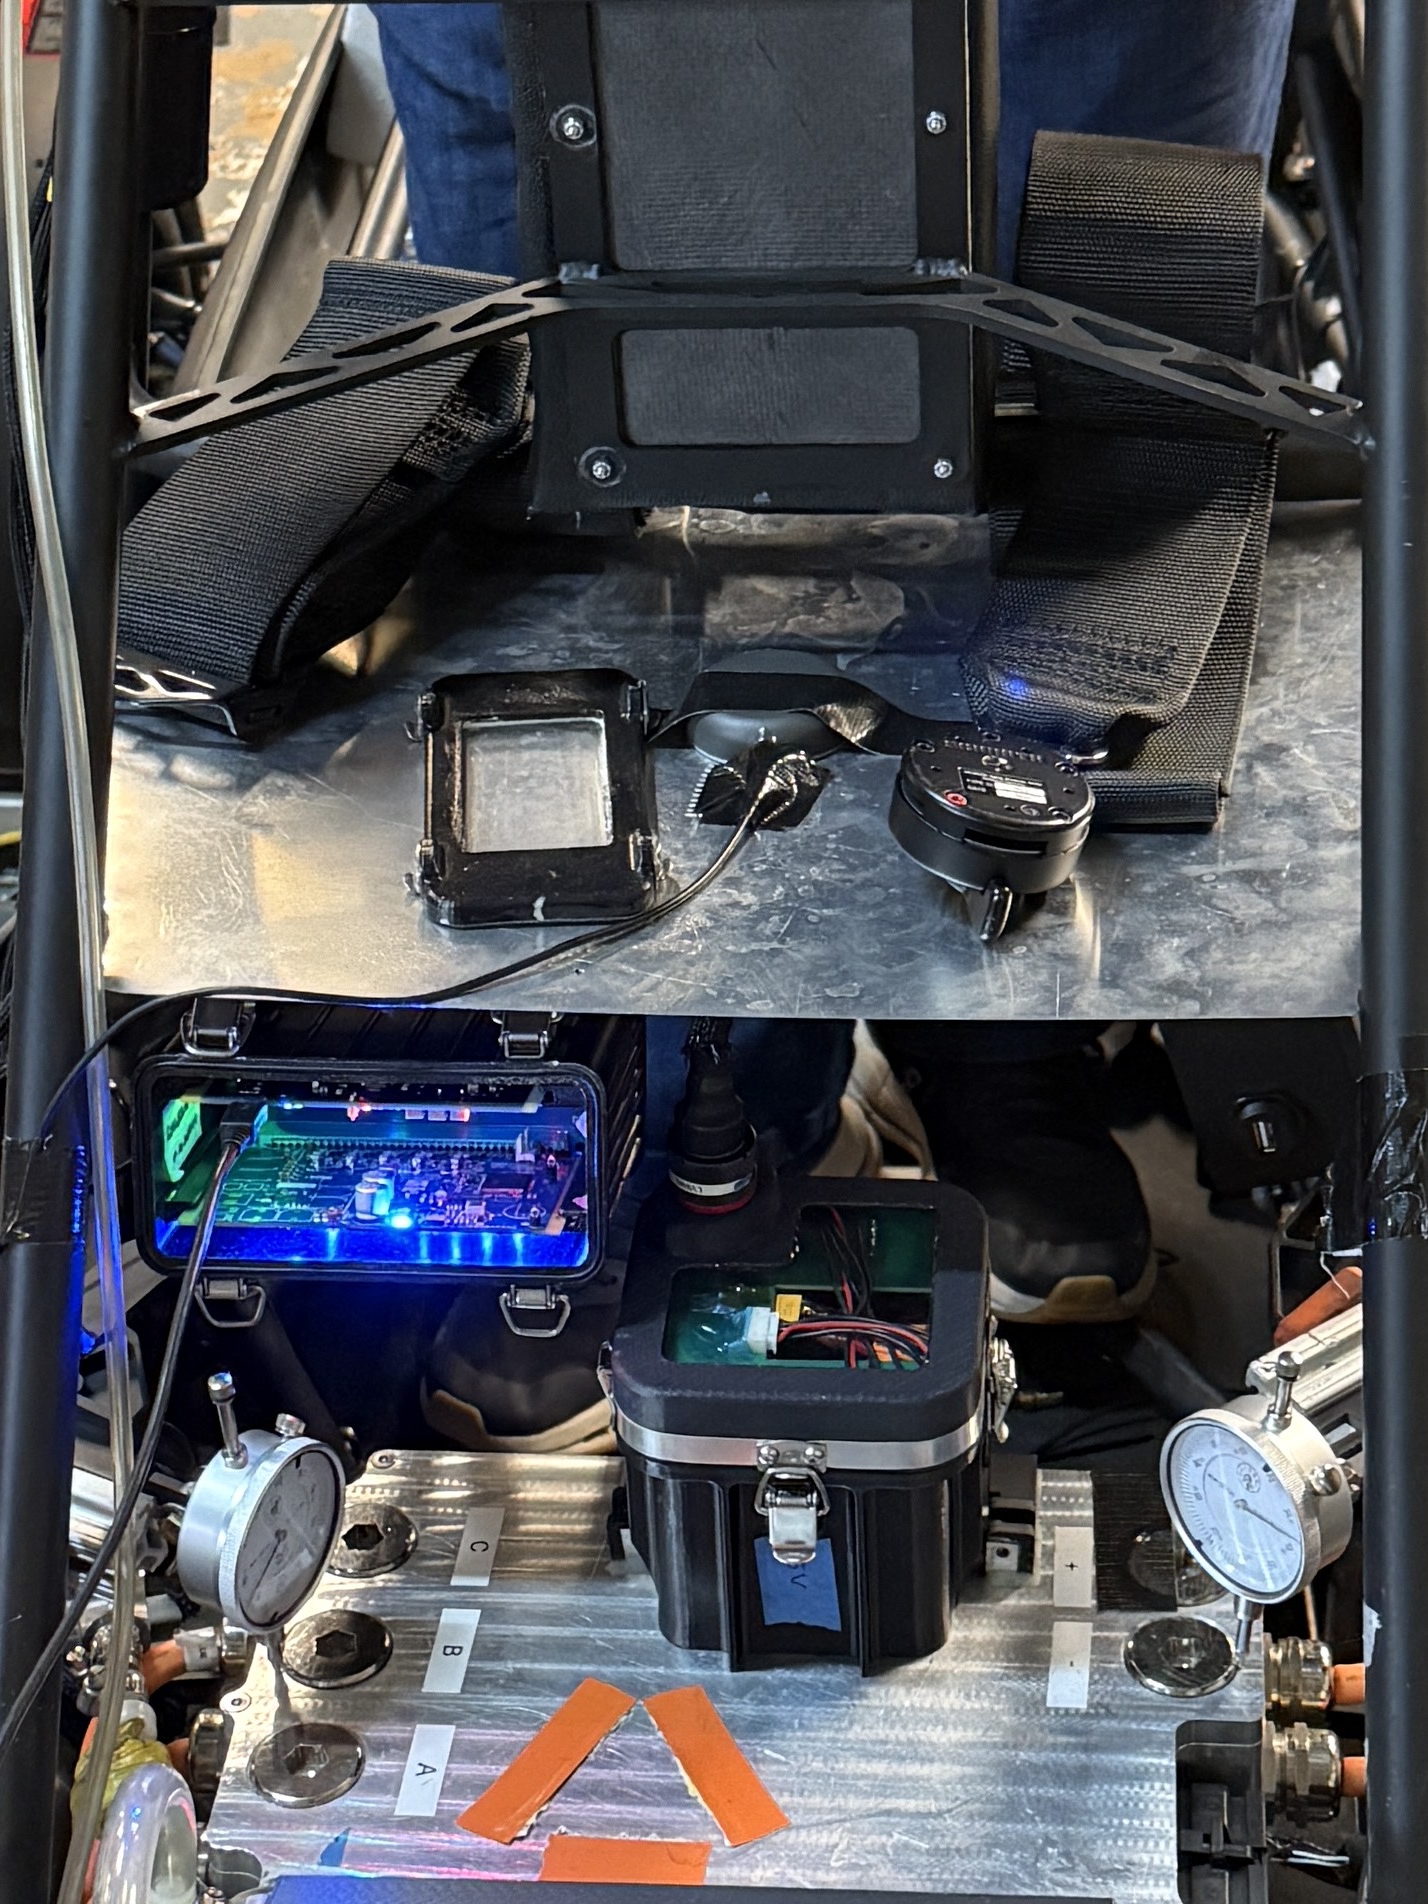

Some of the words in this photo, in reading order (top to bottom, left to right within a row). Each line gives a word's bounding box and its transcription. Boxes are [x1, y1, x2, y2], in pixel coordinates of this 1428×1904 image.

[470, 1540, 489, 1552] C
[443, 1645, 463, 1657] B
[415, 1762, 437, 1777] A
